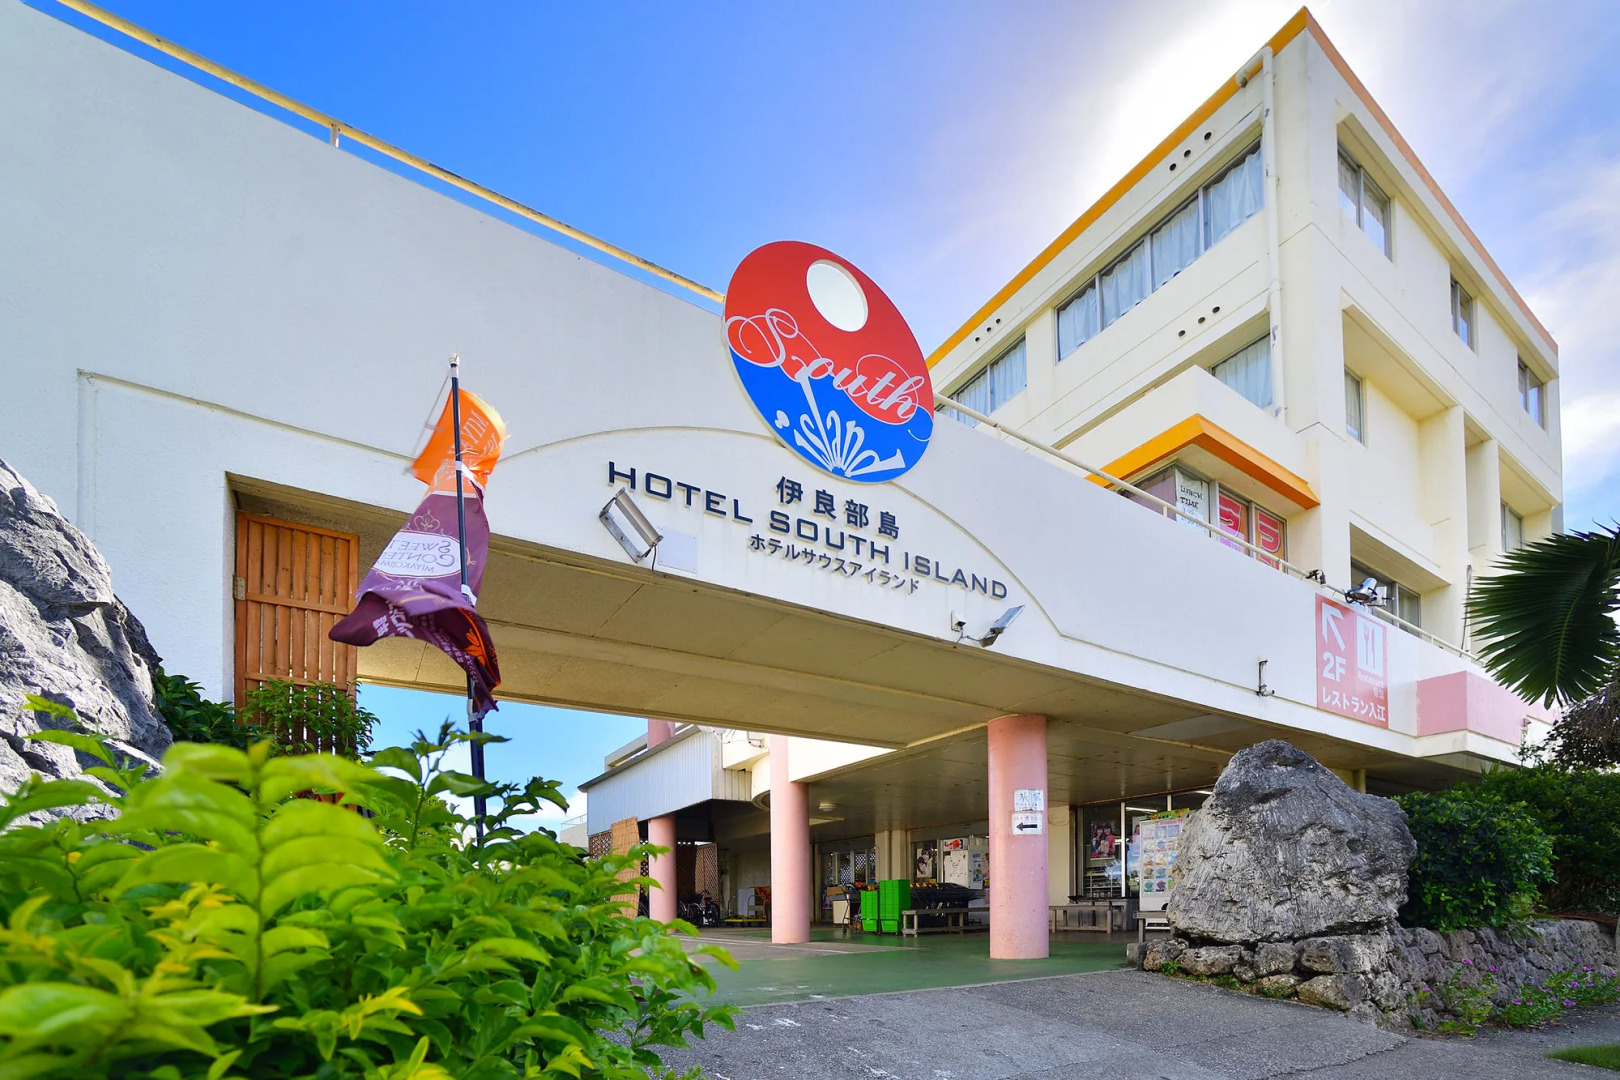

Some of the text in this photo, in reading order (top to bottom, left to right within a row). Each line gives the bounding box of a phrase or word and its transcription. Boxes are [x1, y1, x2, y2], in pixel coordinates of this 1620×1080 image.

[725, 308, 931, 428] South
[608, 461, 1008, 600] HOTEL SOUTH ISLAND
[776, 476, 900, 539] 伊良部島
[1180, 497, 1199, 509] TIME
[750, 533, 920, 594] ホテルサウスアイランド
[1322, 651, 1347, 682] 2F
[1322, 687, 1386, 722] レストラン入江
